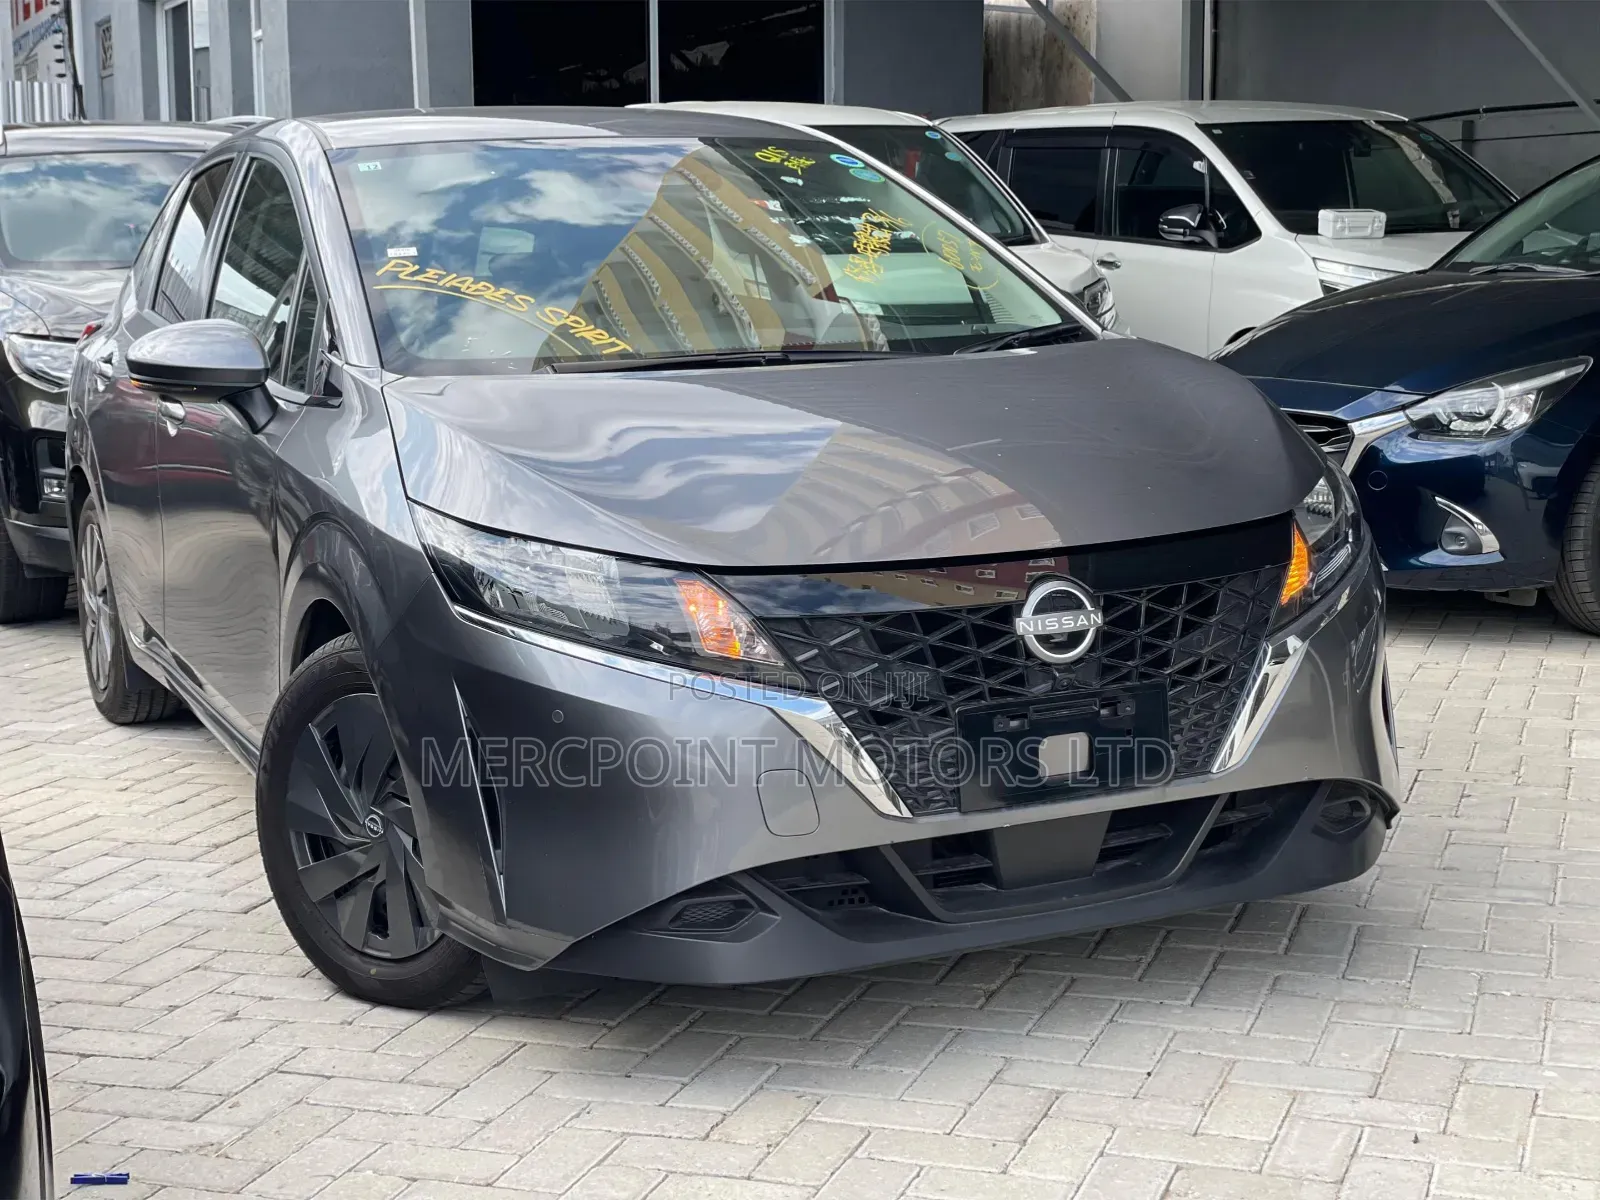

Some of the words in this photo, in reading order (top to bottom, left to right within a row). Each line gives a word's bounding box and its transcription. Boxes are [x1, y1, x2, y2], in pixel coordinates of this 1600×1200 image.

[375, 259, 535, 312] PLEIADES
[536, 307, 633, 354] SPIRIT
[1018, 612, 1102, 634] NISSAN
